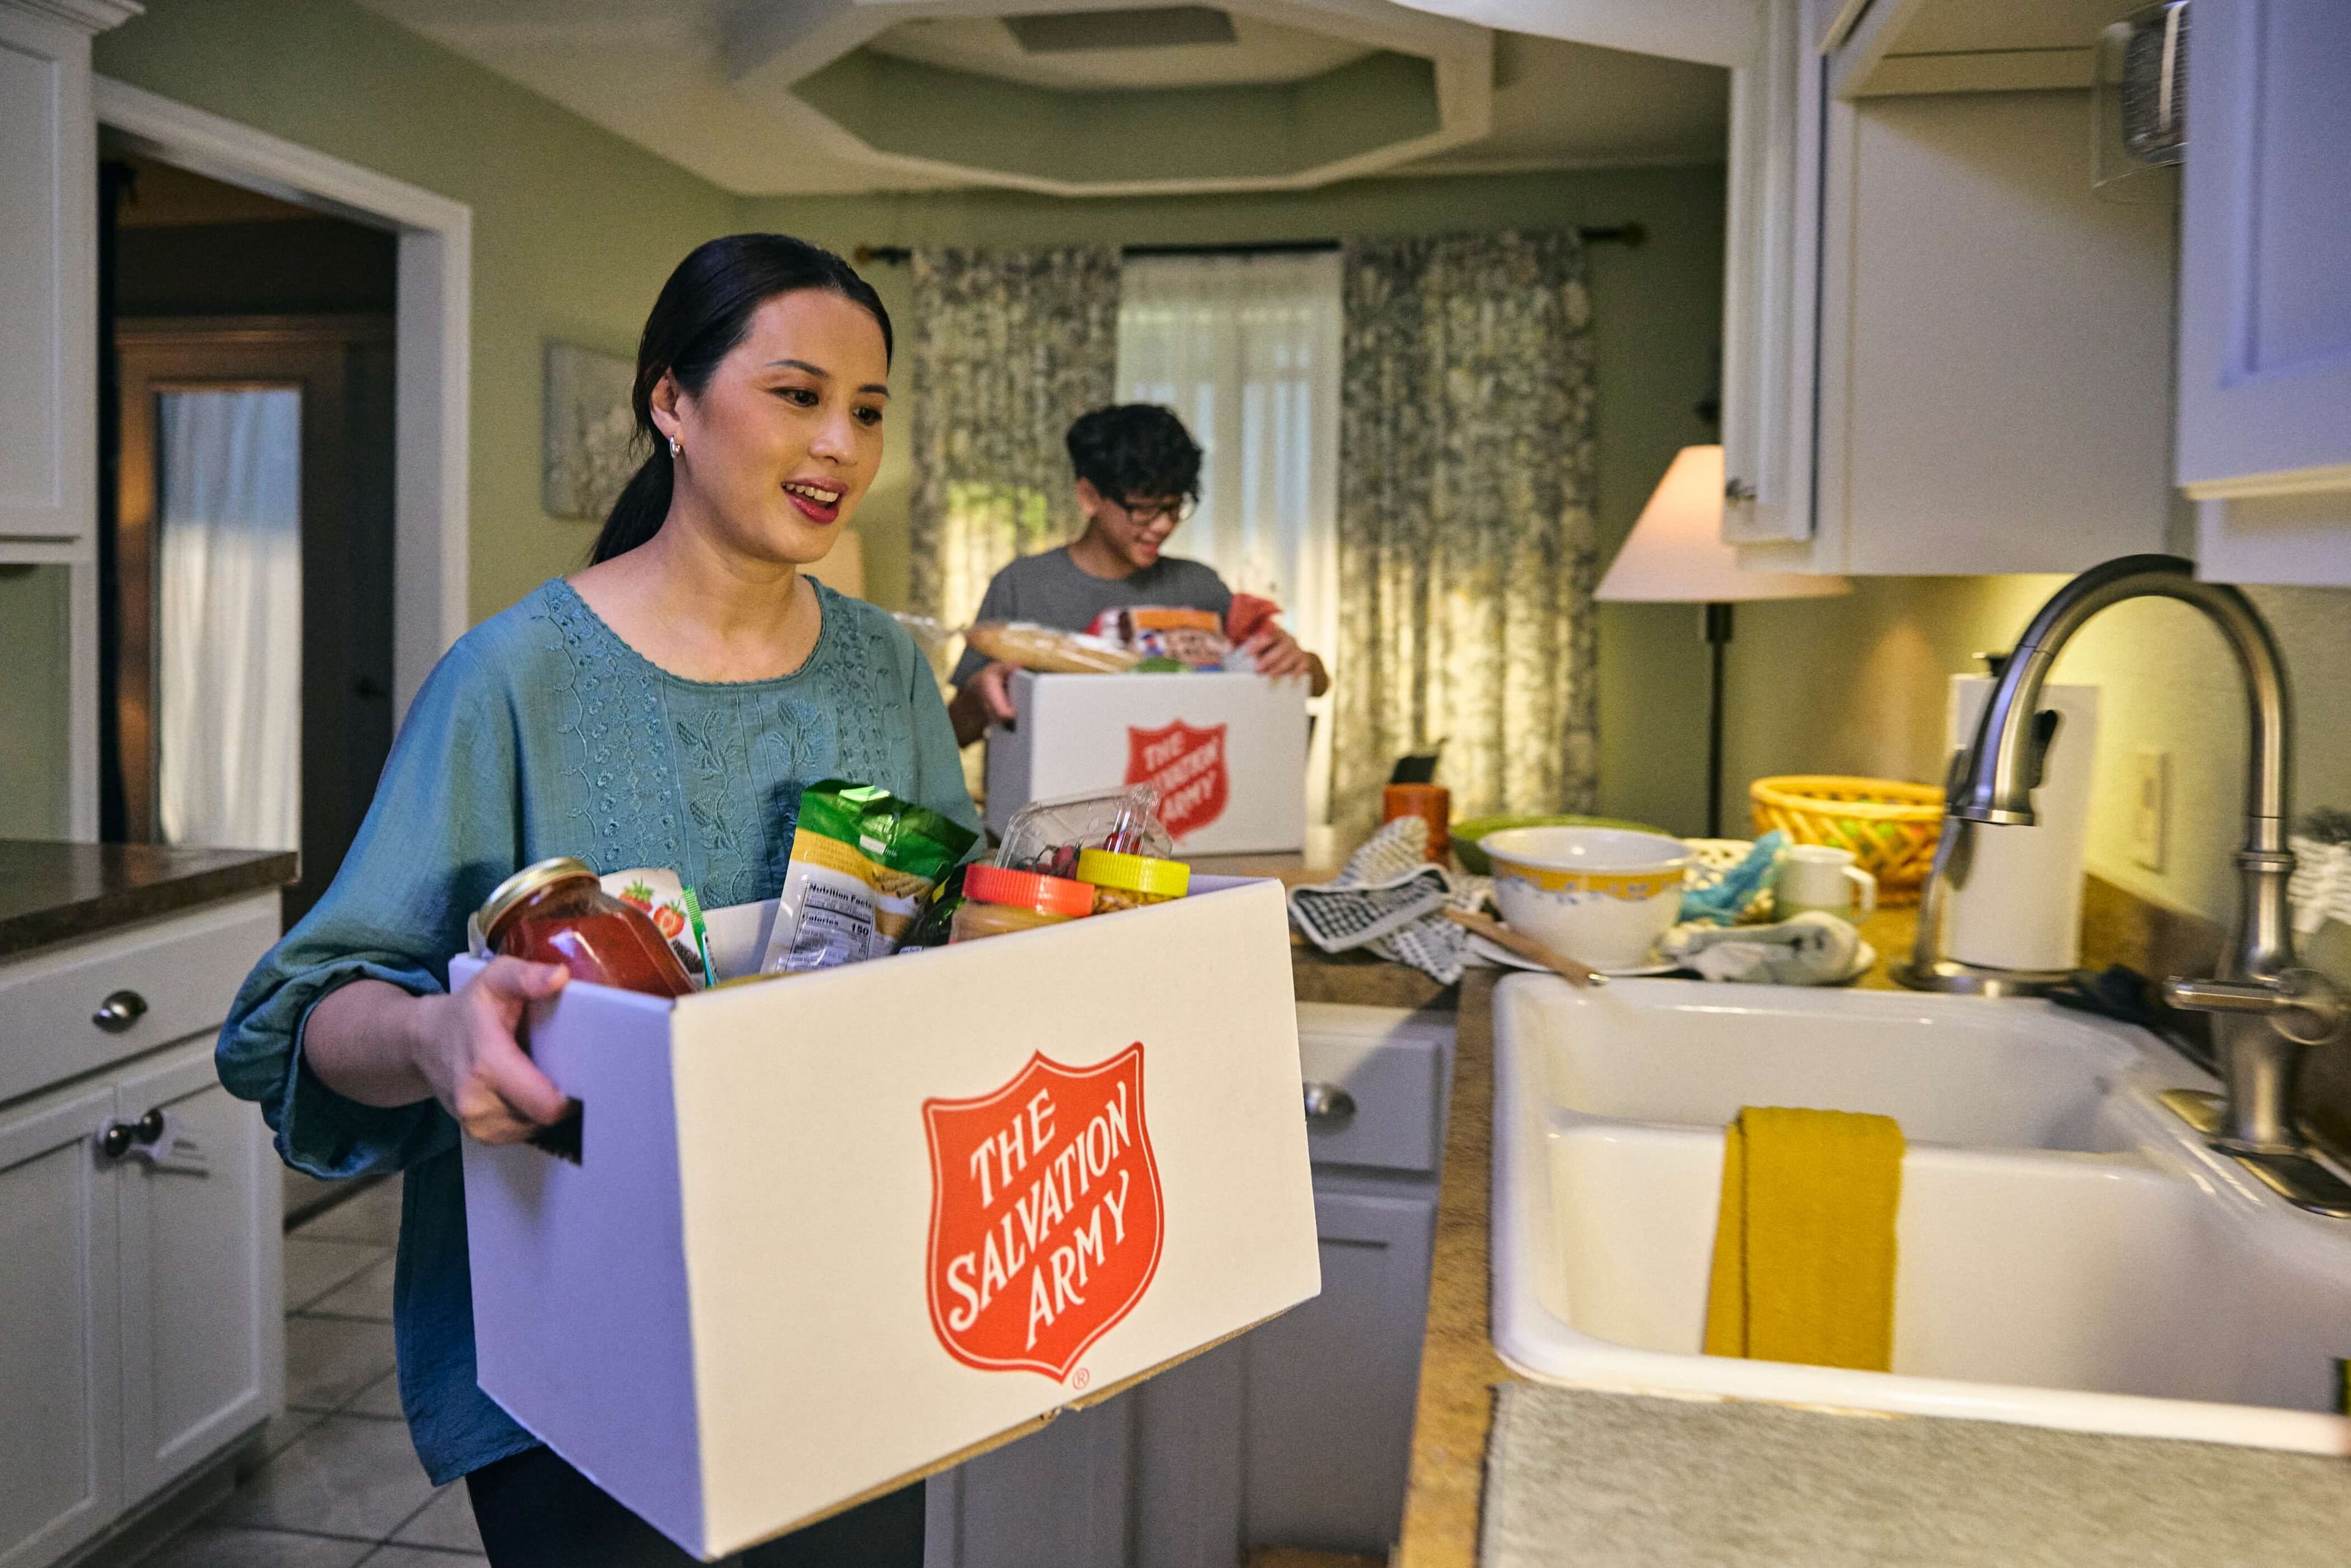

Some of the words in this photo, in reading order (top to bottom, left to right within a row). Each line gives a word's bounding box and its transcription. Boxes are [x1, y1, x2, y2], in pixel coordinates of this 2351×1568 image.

[802, 913, 839, 926] Calories
[809, 883, 849, 901] Nutrition
[850, 894, 872, 909] Facts
[947, 1081, 1131, 1332] SALVATION
[970, 1087, 1056, 1209] THE
[1026, 1169, 1130, 1352] ARMY
